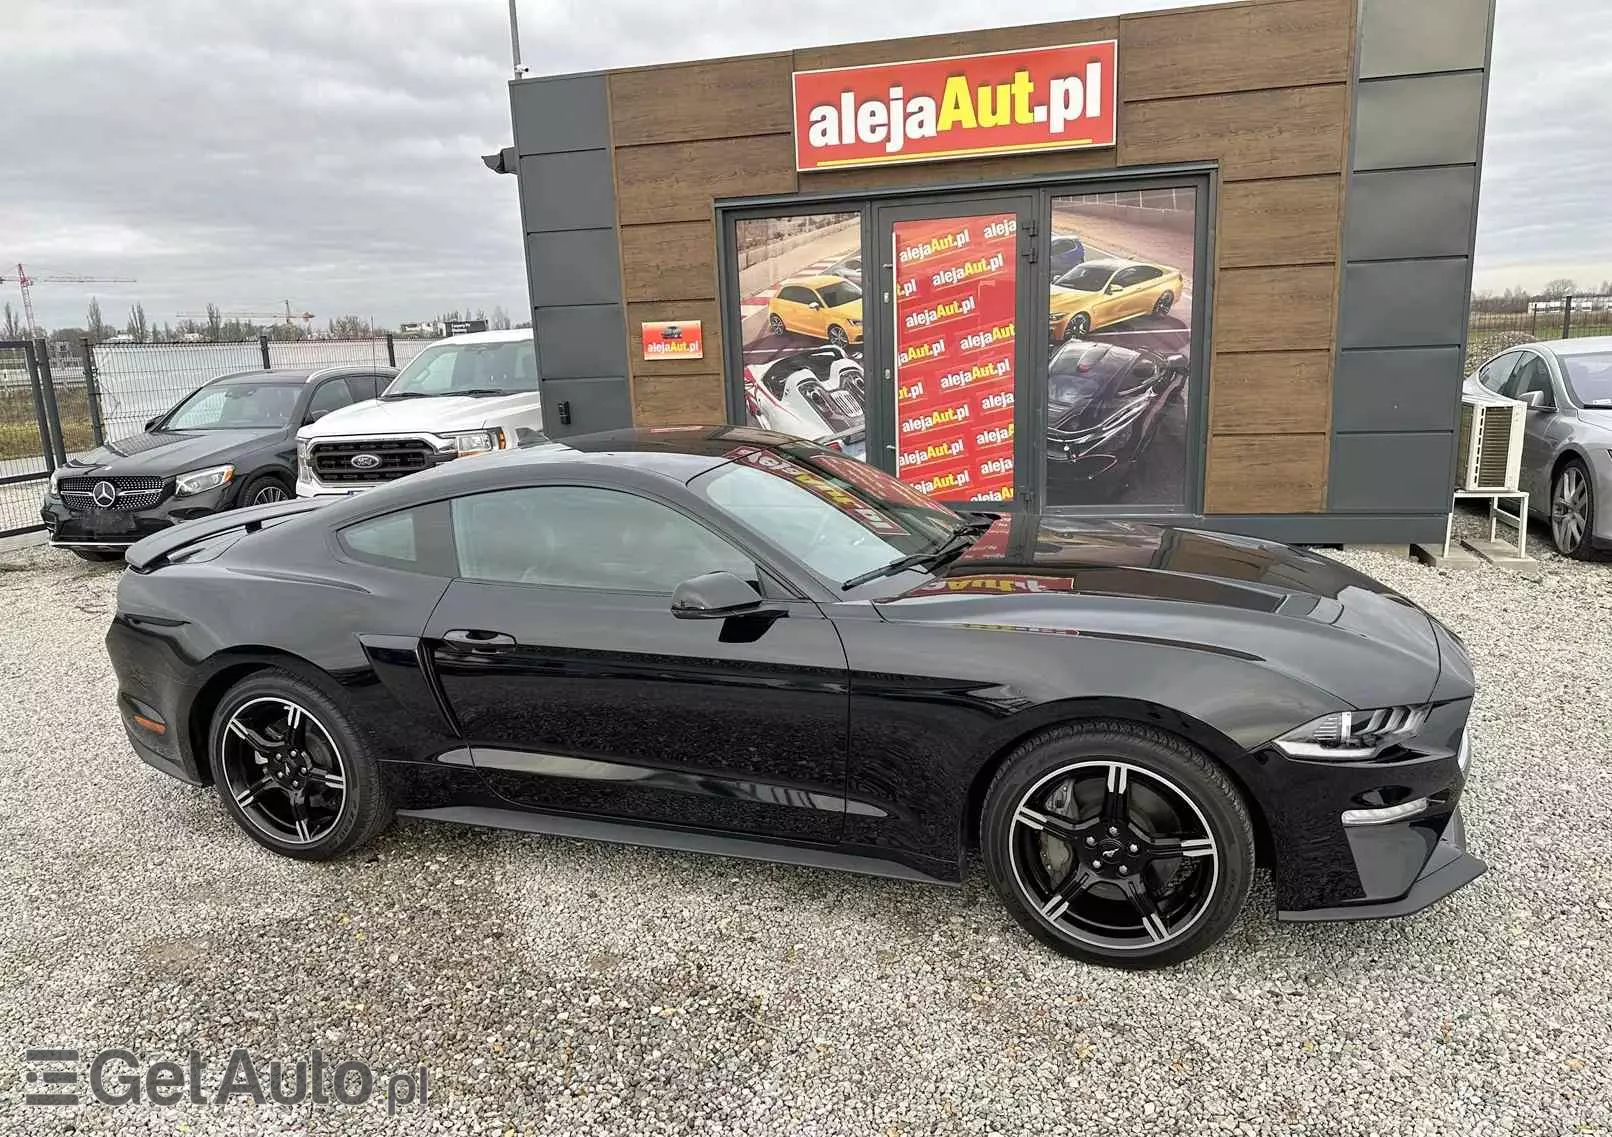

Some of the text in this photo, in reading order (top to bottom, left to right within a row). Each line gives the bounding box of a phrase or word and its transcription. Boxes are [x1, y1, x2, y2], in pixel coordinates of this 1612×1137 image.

[808, 62, 1102, 153] alejaAut.pl
[984, 219, 1016, 239] aleja
[899, 229, 970, 263] alejaAut.pl
[932, 253, 1004, 286] alejaAut.pl
[905, 296, 976, 327] alejaAut.pl
[648, 341, 699, 354] alejaAut.pl
[960, 323, 1015, 350] alejaAut
[940, 358, 1010, 389] alejaAut.pl
[982, 391, 1014, 409] aleja
[902, 404, 970, 433] alejaAut.pl
[899, 439, 964, 466] alejaAut.pl
[981, 458, 1013, 475] aleja
[911, 470, 970, 495] ejaAut.pl
